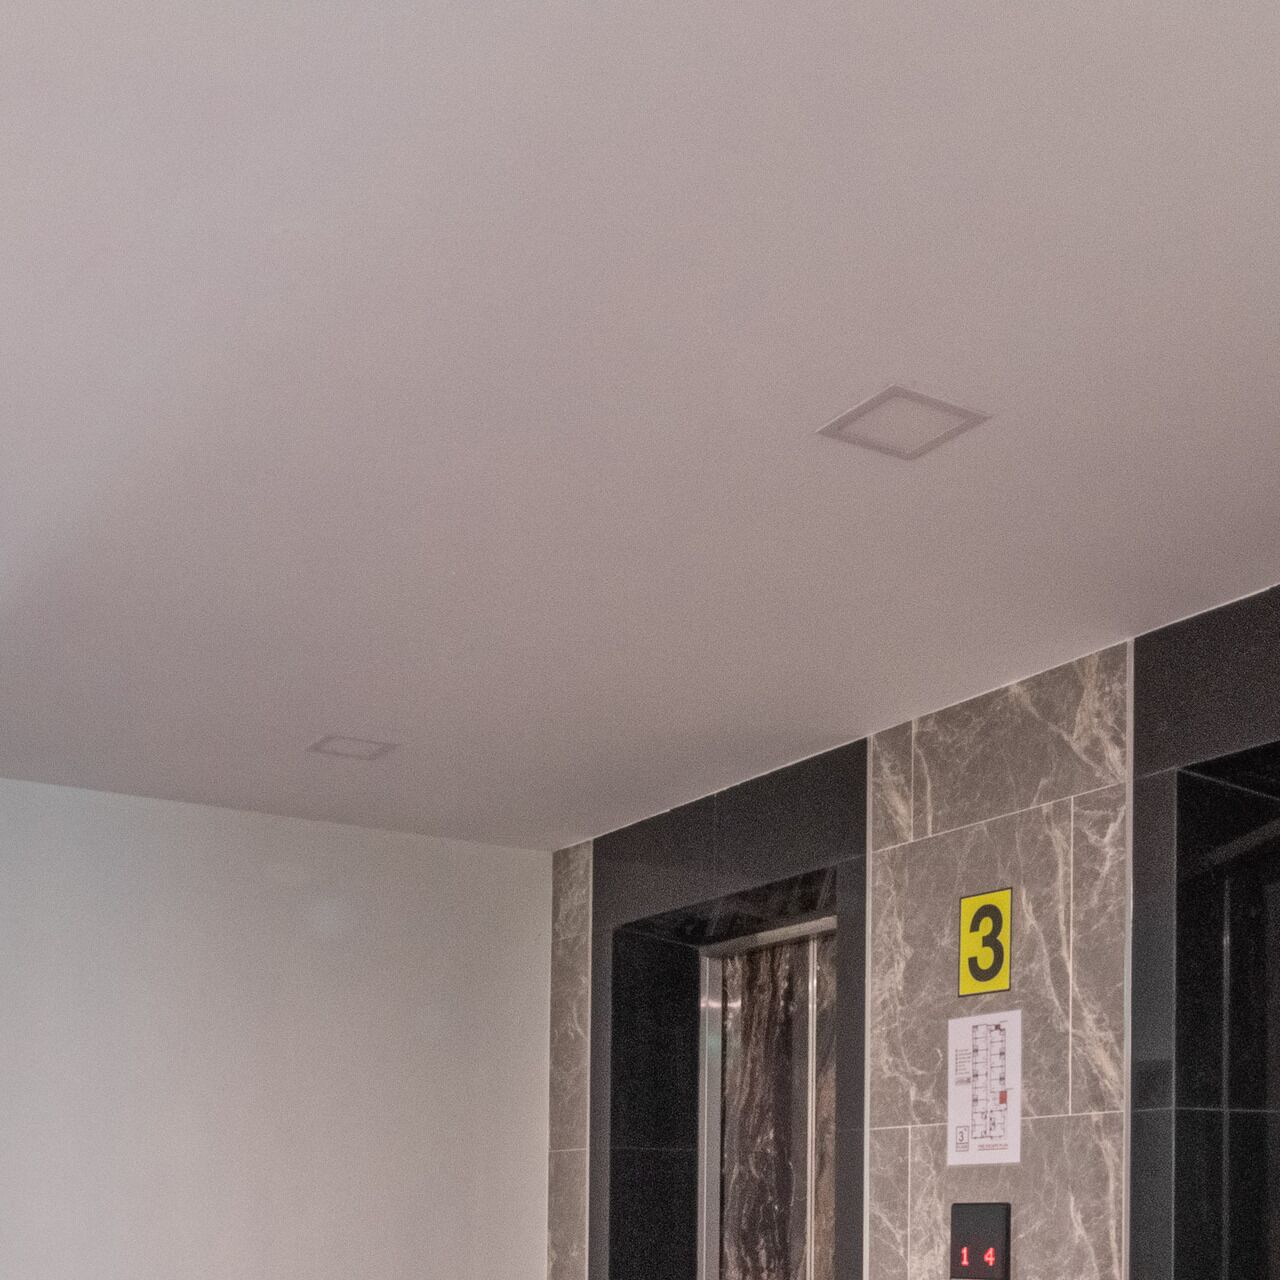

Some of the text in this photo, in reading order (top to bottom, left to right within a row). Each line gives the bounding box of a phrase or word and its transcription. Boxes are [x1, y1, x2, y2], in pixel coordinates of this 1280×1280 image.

[968, 904, 1004, 982] 3
[961, 1247, 995, 1266] 1 4
